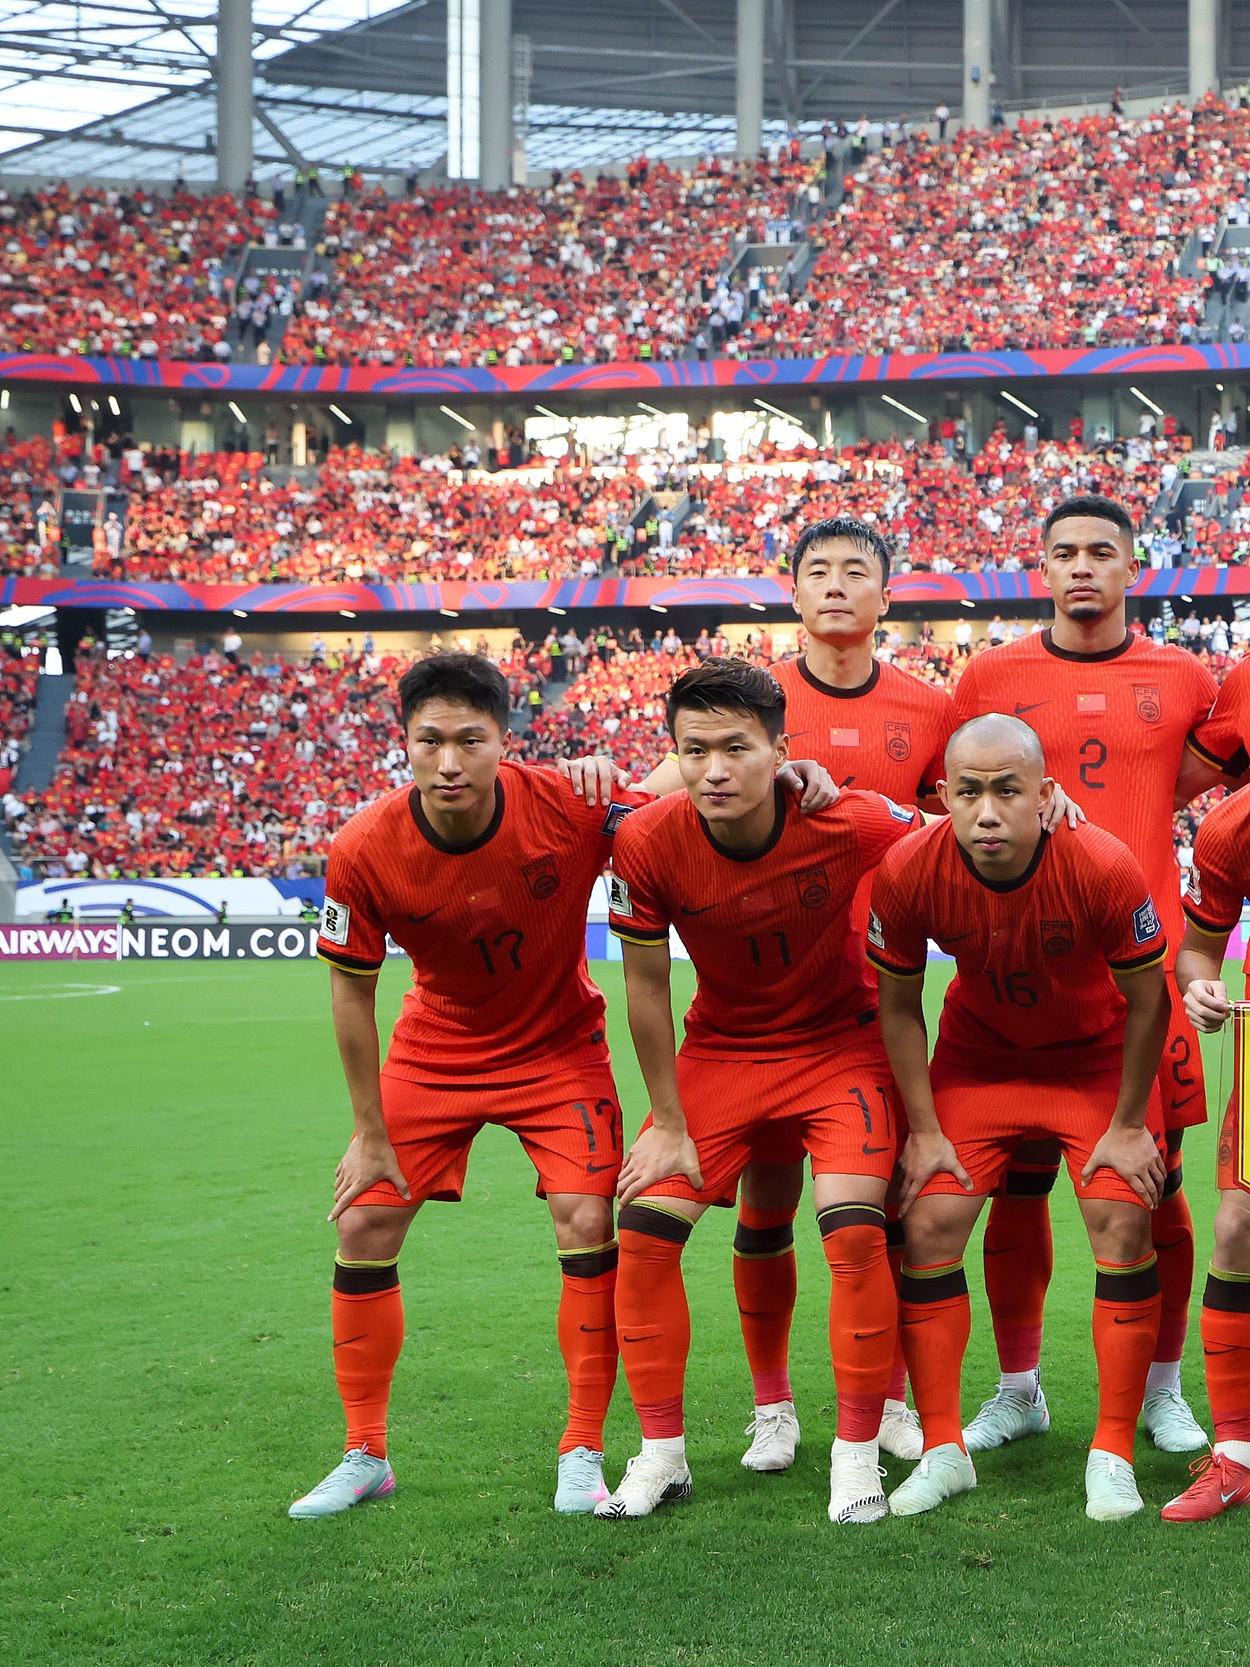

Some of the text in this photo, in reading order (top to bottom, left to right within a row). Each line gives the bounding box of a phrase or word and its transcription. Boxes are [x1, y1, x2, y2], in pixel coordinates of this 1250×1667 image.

[887, 724, 908, 733] CFA
[1078, 738, 1107, 789] 2
[472, 928, 525, 976] 17
[744, 930, 793, 967] 11
[984, 971, 1039, 1009] 16
[1169, 1035, 1195, 1087] 2
[572, 1099, 618, 1153] 17
[847, 1086, 891, 1139] 11
